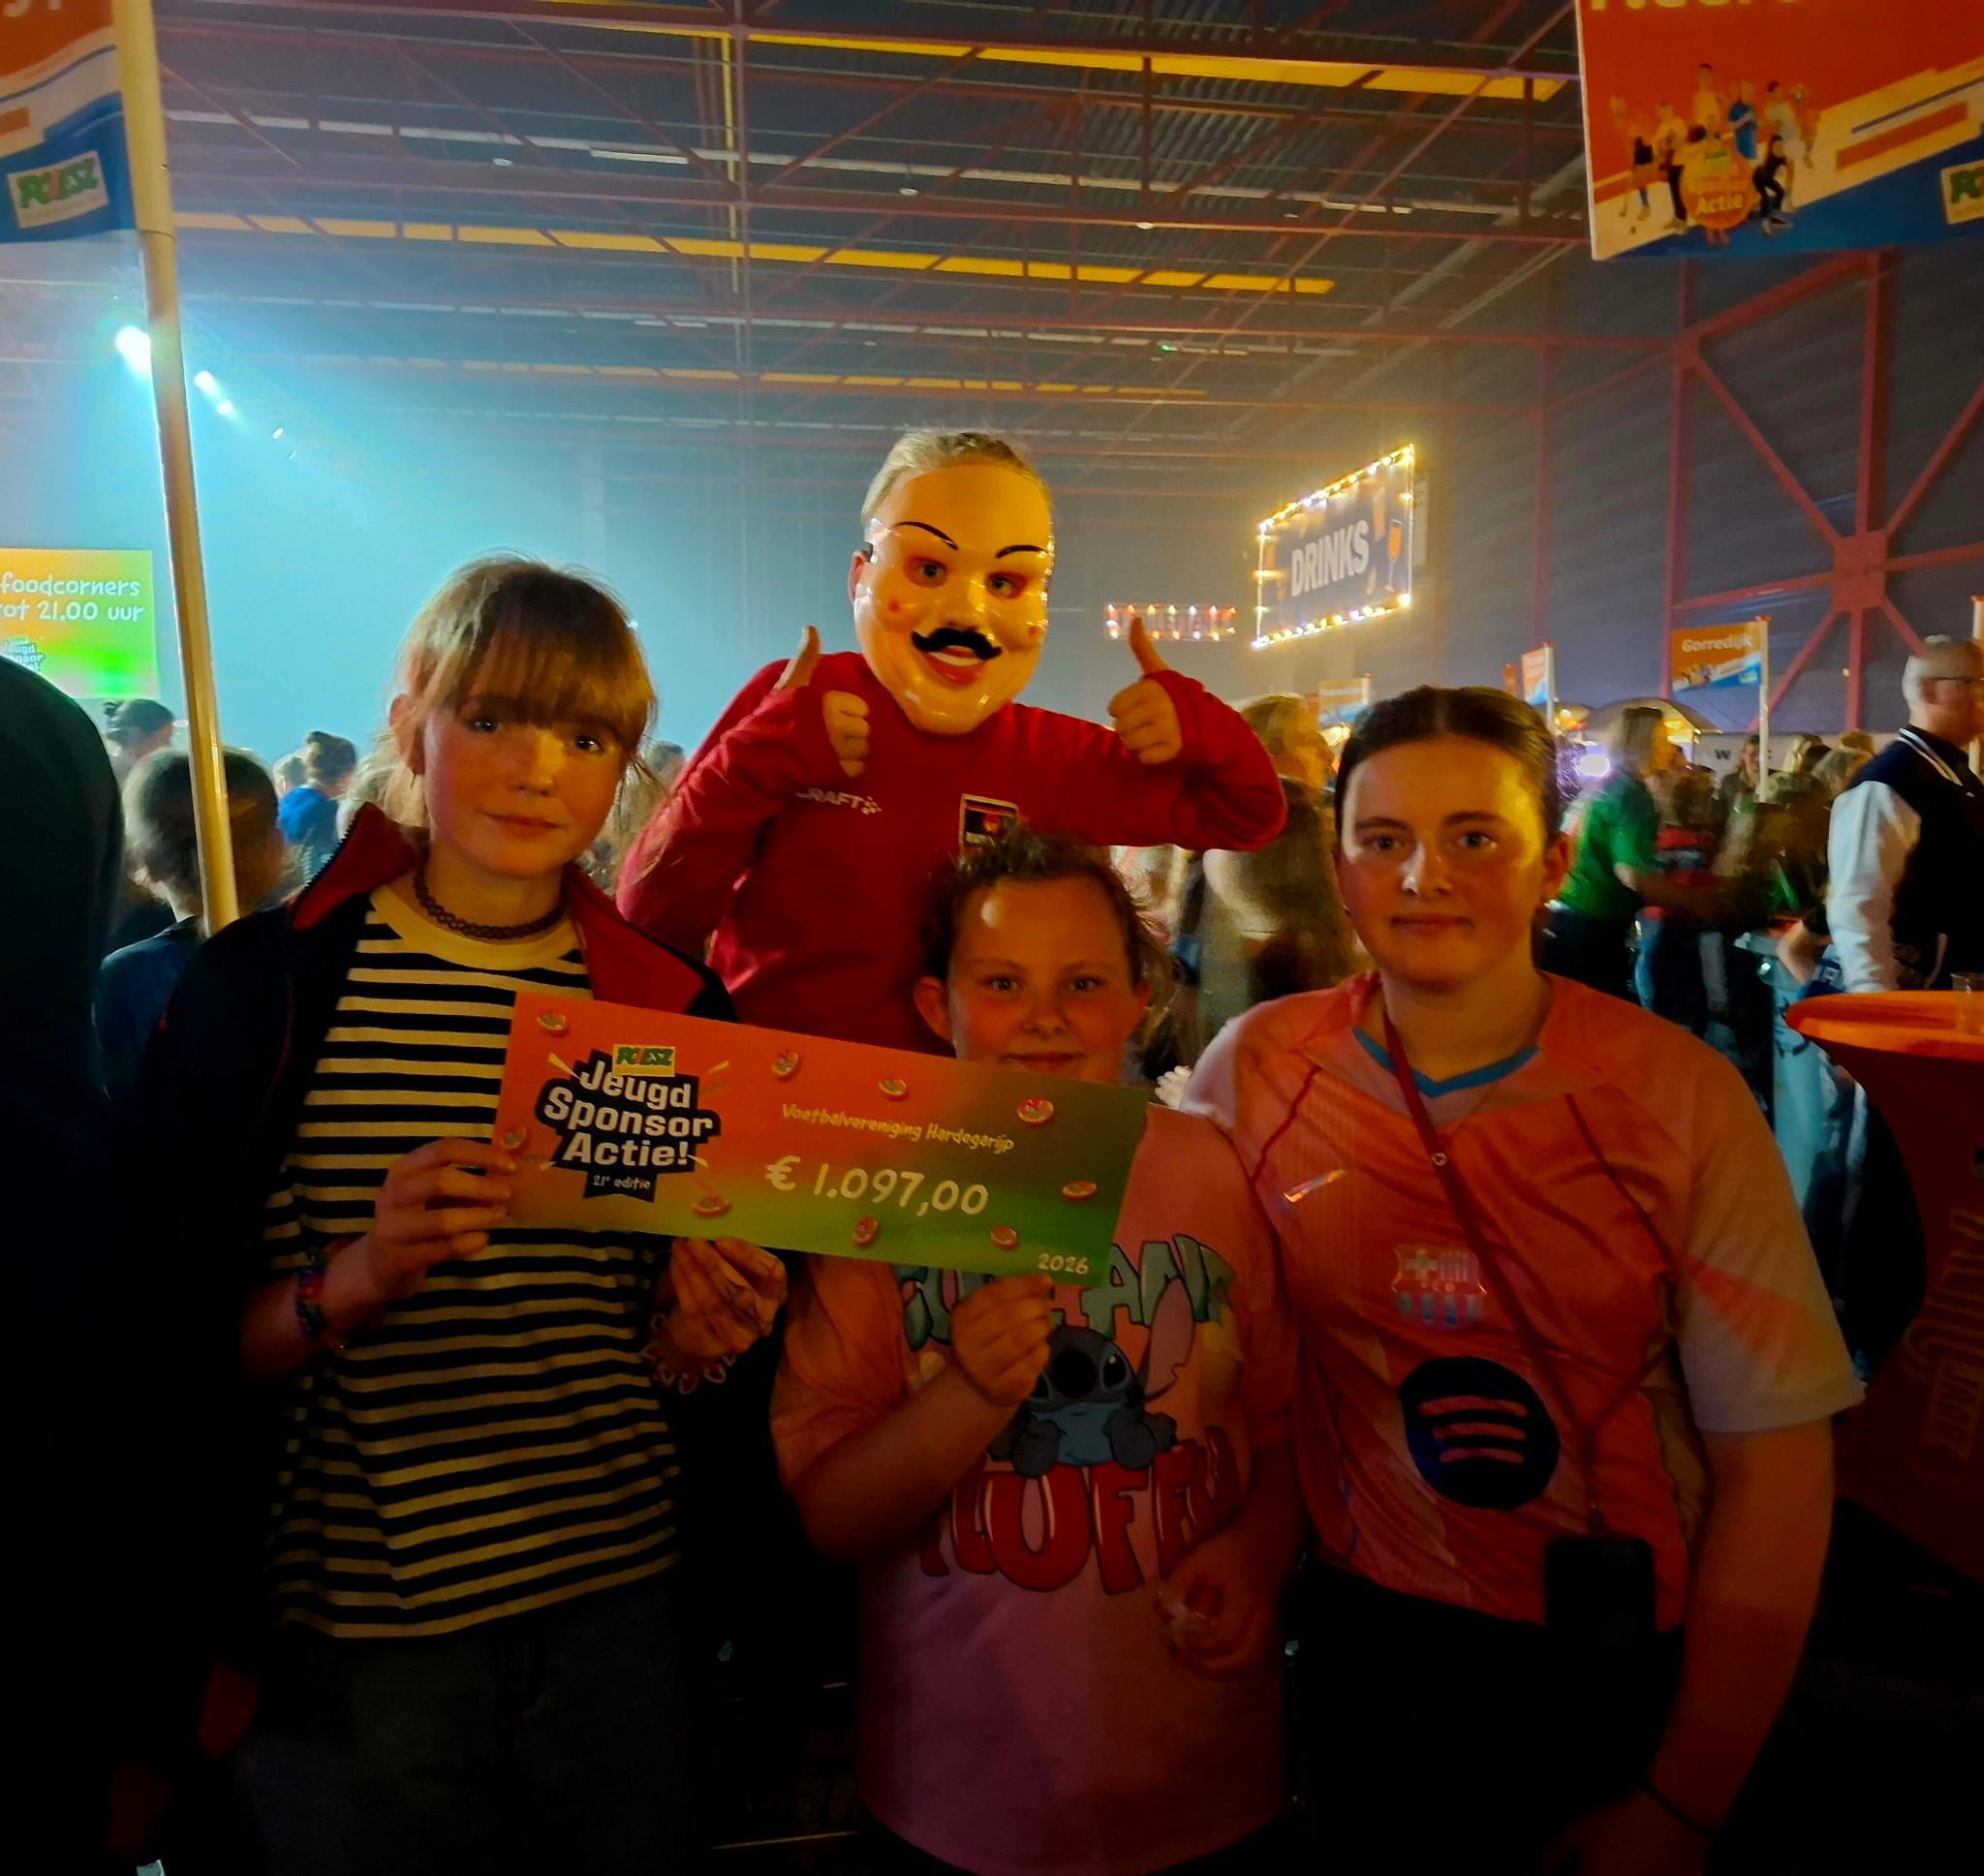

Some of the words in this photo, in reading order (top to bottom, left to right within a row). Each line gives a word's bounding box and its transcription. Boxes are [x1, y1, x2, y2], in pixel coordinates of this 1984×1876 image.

[1291, 520, 1370, 598] DRINKS
[2, 571, 140, 597] foodcorners
[39, 600, 99, 621] 21.00
[108, 605, 145, 622] uur
[579, 1061, 692, 1111] Jeugd
[543, 1086, 714, 1138] Sponsor
[782, 1102, 922, 1141] Voetbalvereniging
[562, 1131, 689, 1167] Actie!
[764, 1154, 800, 1191] €
[814, 1163, 989, 1217] 1.097,00
[1038, 1251, 1089, 1275] 2026
